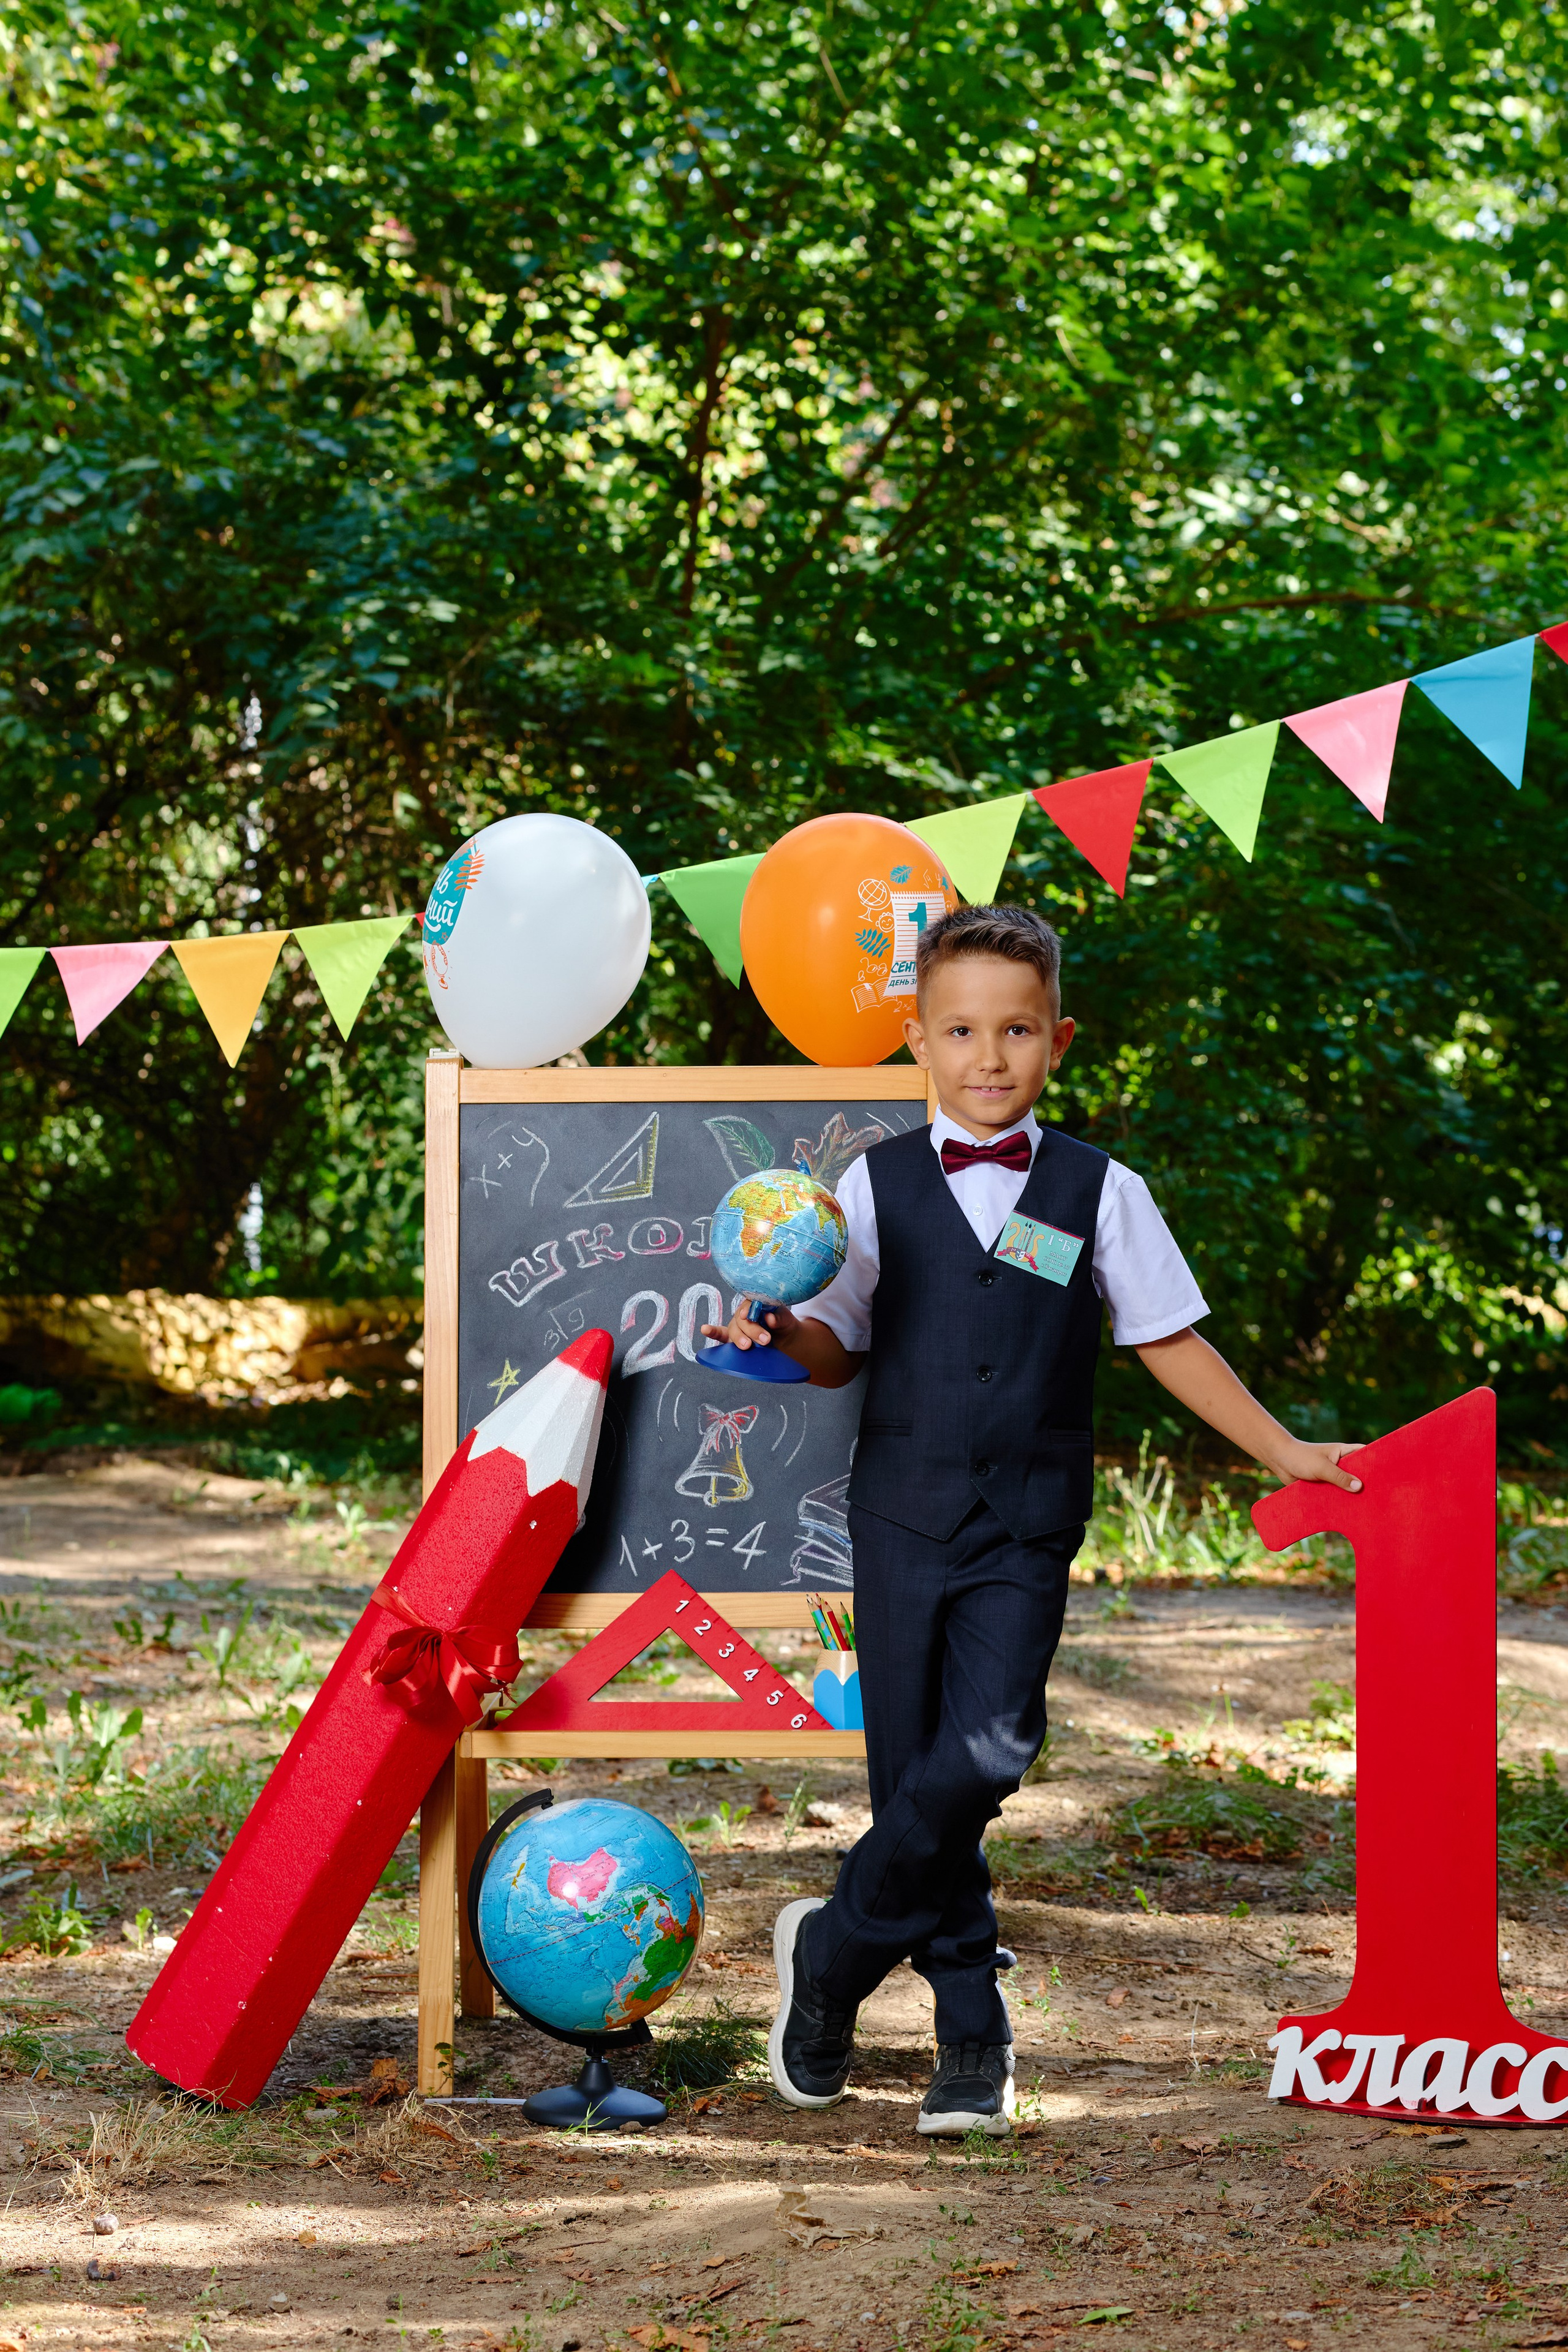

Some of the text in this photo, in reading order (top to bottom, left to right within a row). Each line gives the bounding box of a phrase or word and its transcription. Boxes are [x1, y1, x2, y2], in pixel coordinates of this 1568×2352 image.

[908, 902, 928, 937] 1
[888, 978, 910, 988] ДЕНЬ
[1047, 1234, 1055, 1246] 1
[620, 1282, 746, 1380] 20
[674, 1599, 807, 1729] 1 2 3 4 5 6
[1267, 2026, 1568, 2120] класс
